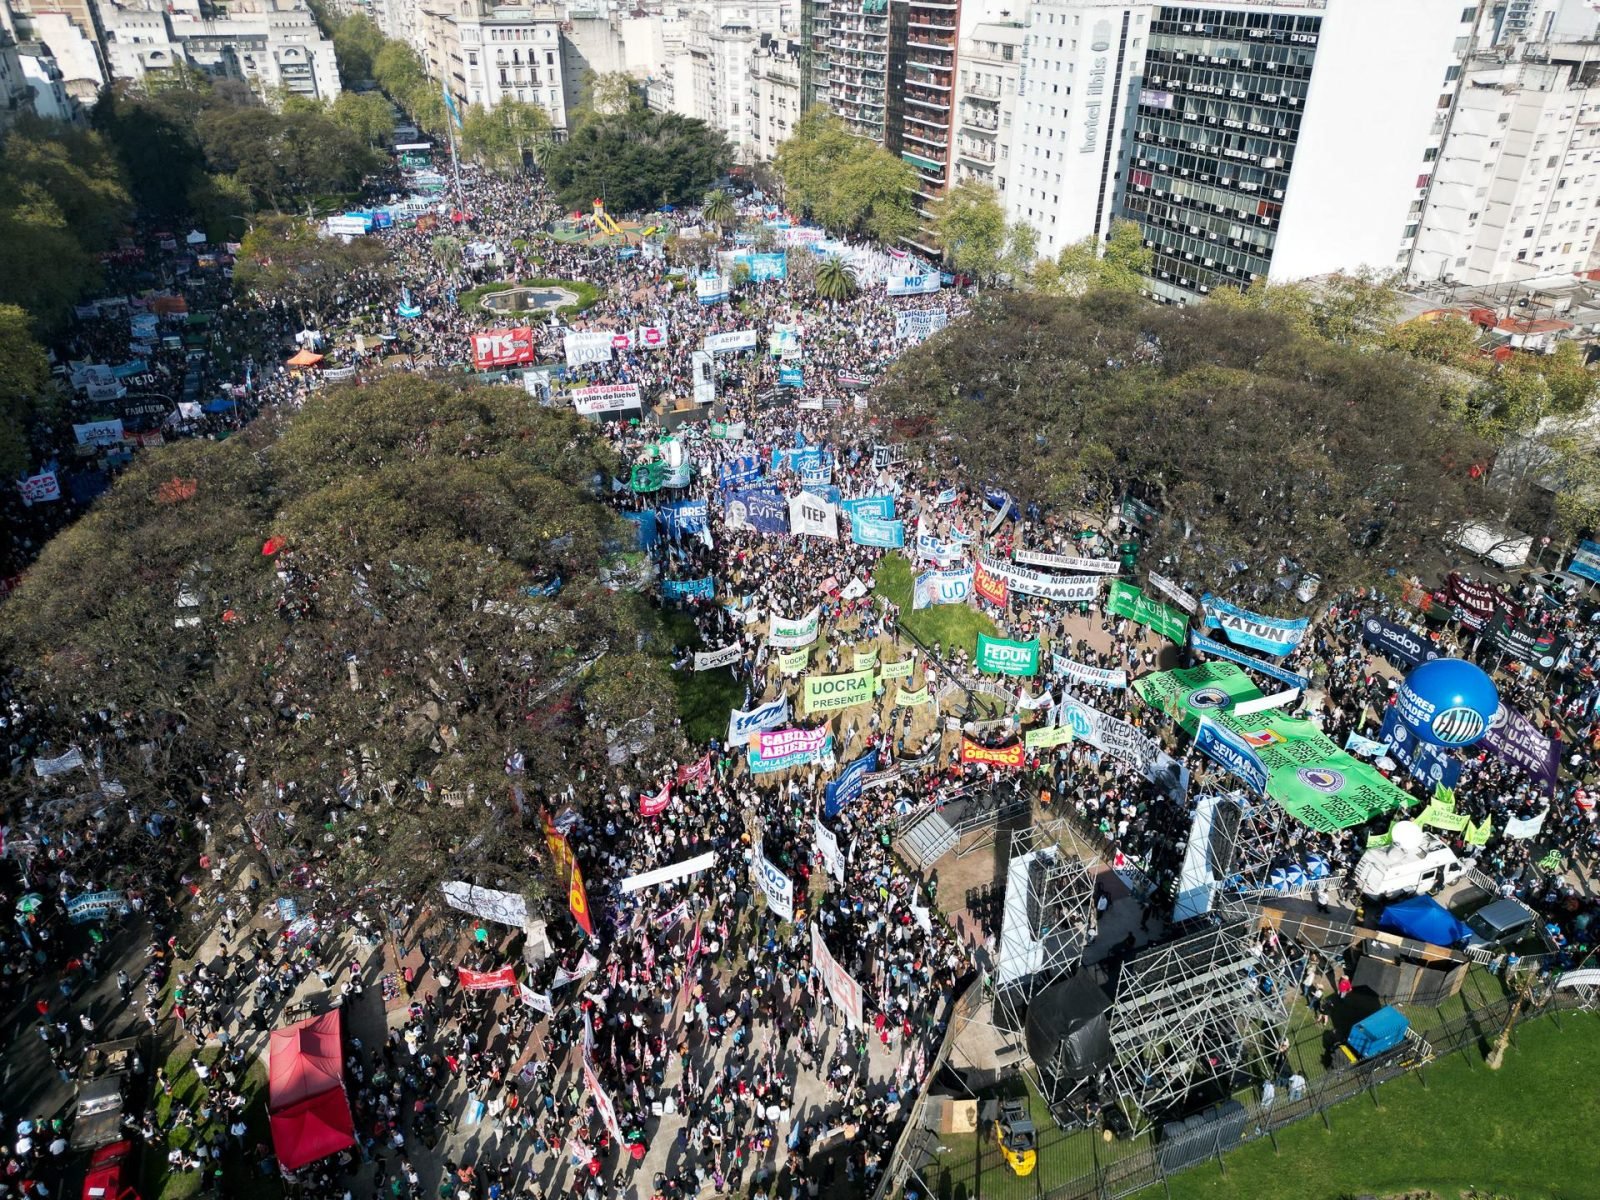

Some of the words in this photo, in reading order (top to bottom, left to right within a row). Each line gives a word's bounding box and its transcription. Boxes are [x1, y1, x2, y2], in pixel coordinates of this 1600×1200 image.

[1086, 57, 1107, 96] ibis
[1079, 101, 1101, 153] hotel
[476, 333, 515, 360] PTS
[572, 346, 610, 361] APOPS
[576, 386, 599, 396] PARO
[600, 384, 636, 395] GENERAL
[584, 393, 602, 404] plan
[603, 392, 614, 400] de
[614, 391, 637, 400] lucha
[803, 467, 831, 480] MTE
[674, 505, 707, 518] LIBRES
[982, 557, 1039, 581] UNIVERSIDAD
[1050, 574, 1098, 585] NACIONAL
[1032, 584, 1095, 598] ZAMORA
[1219, 611, 1286, 642] FATUN
[1382, 628, 1421, 655] sadop
[784, 653, 806, 665] UOCRA
[984, 643, 1031, 662] FEDUN
[811, 677, 867, 695] UOCRA
[812, 692, 866, 709] PRESENTE
[762, 726, 827, 747] CABILDO
[762, 738, 826, 759] ABIERTO
[1484, 727, 1541, 773] RESENTE
[753, 760, 769, 769] POR
[770, 759, 781, 767] LA
[1384, 733, 1435, 786] PRESENT
